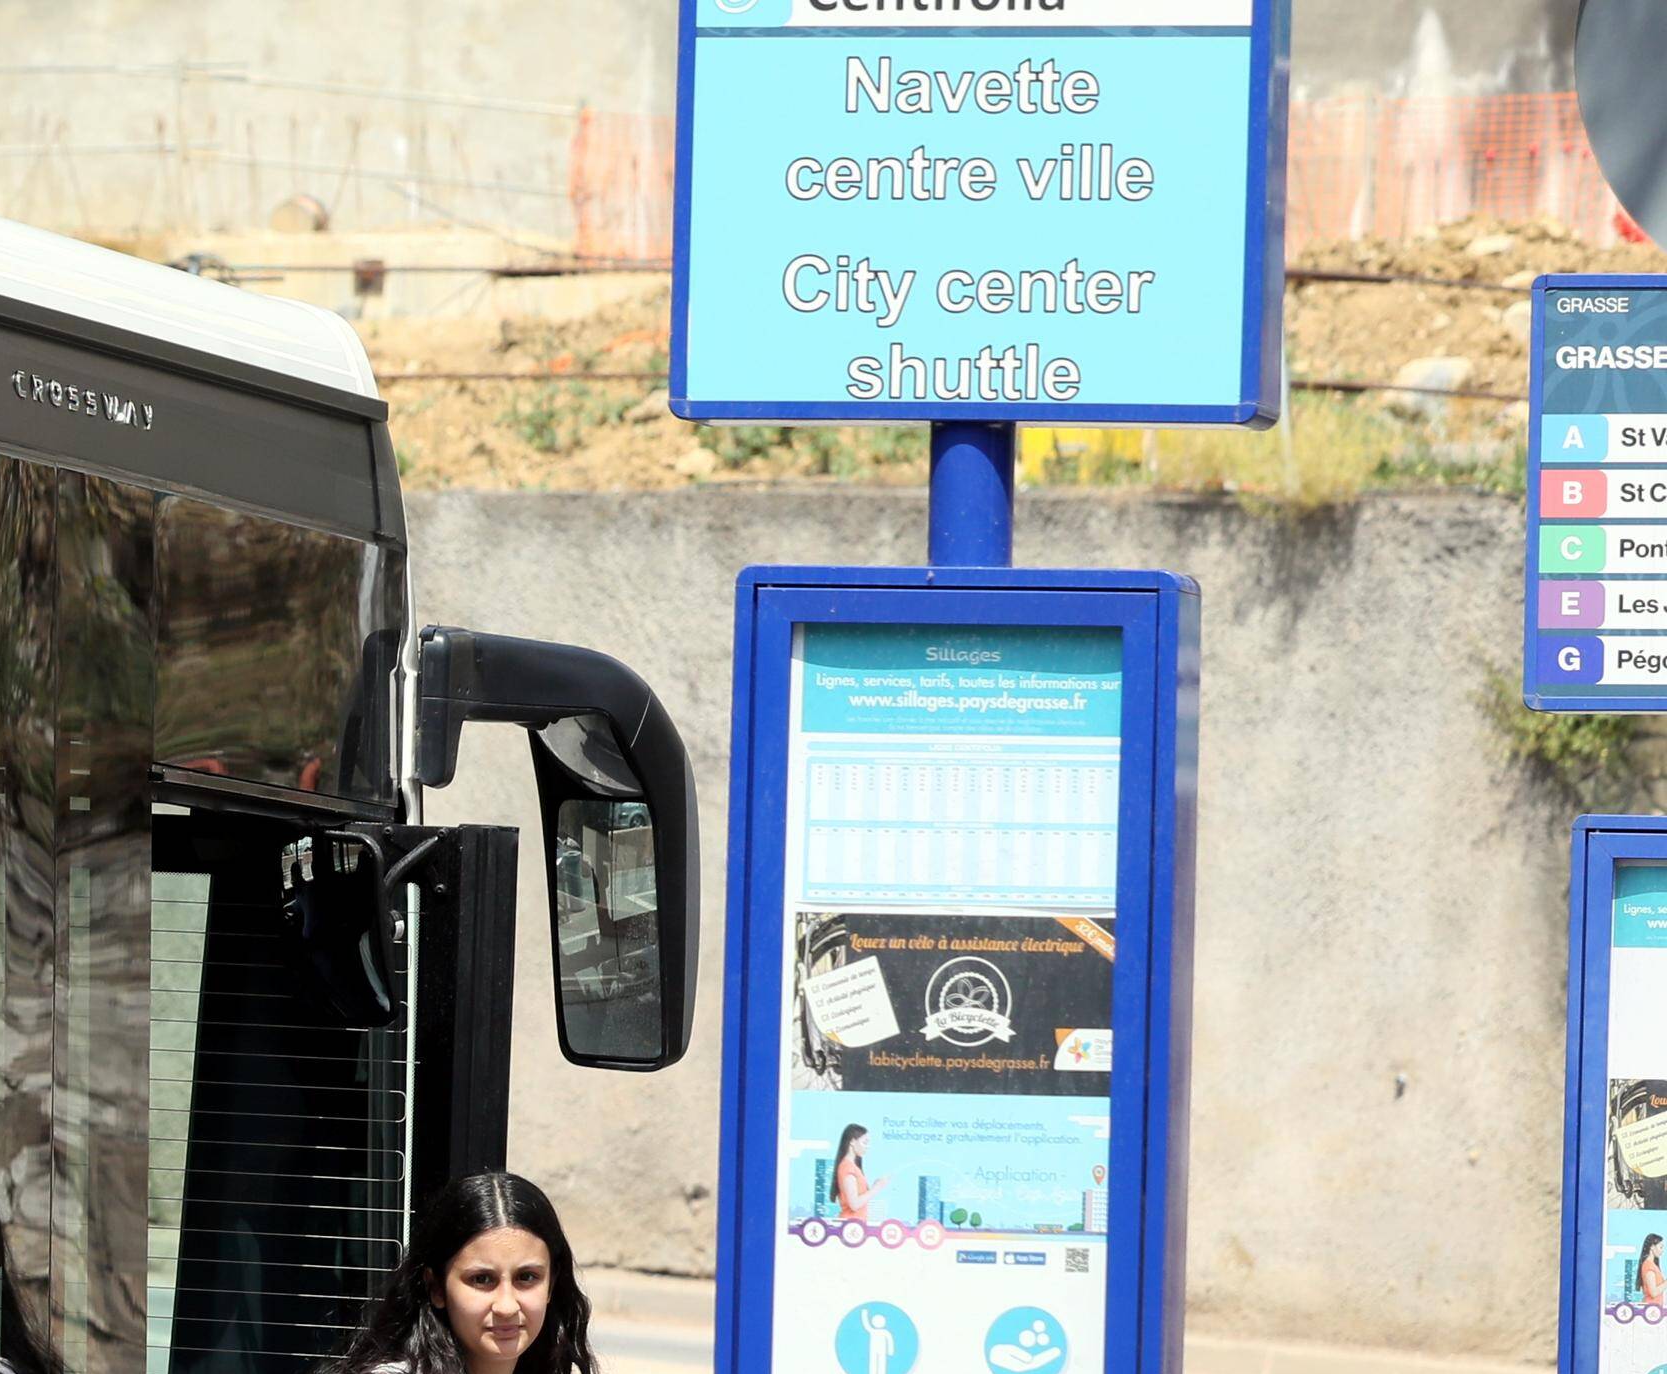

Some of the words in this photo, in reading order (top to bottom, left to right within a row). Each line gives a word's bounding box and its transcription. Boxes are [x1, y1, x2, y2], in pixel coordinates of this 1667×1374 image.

[845, 55, 1100, 115] Navette
[785, 145, 998, 202] centre
[1016, 143, 1156, 202] ville
[781, 253, 917, 329] City
[936, 257, 1157, 315] center
[1556, 297, 1630, 314] GRASSE
[1554, 344, 1667, 371] GRASSE
[845, 342, 1083, 402] shuttle
[12, 369, 154, 431] CROSSWAY
[1561, 424, 1585, 449] A
[1620, 427, 1646, 448] St
[1561, 480, 1584, 505] B
[1619, 482, 1646, 504] St
[1559, 535, 1583, 561] C
[1560, 591, 1580, 616] E
[1618, 594, 1659, 614] Les
[925, 645, 1001, 665] Sillages
[1557, 645, 1581, 672] G
[816, 672, 859, 690] Lignes,
[862, 674, 916, 689] services,
[918, 673, 955, 690] tarifs,
[958, 674, 996, 689] toutes
[998, 674, 1016, 689] les
[1018, 674, 1098, 691] informations
[1099, 678, 1121, 690] sur
[848, 690, 1089, 714] www.sillages.paysdegrasse.fr
[1623, 903, 1655, 917] Lignes,
[850, 932, 886, 951] Louez
[889, 938, 906, 950] un
[909, 935, 935, 950] vélo
[937, 936, 949, 950] à
[950, 939, 1018, 952] assistance
[1020, 937, 1085, 957] électrique
[948, 1010, 1002, 1029] Bicyclette
[869, 1050, 1052, 1074] labicyclette.paysdegrasse.fr
[883, 1116, 906, 1128] Pour
[909, 1116, 948, 1128] faciliter
[950, 1120, 969, 1129] vos
[971, 1117, 1048, 1132] déplacements,
[882, 1130, 944, 1144] téléchargez
[946, 1131, 1012, 1145] gratuitement
[1014, 1132, 1083, 1146] l'application.
[974, 1165, 1058, 1185] Application
